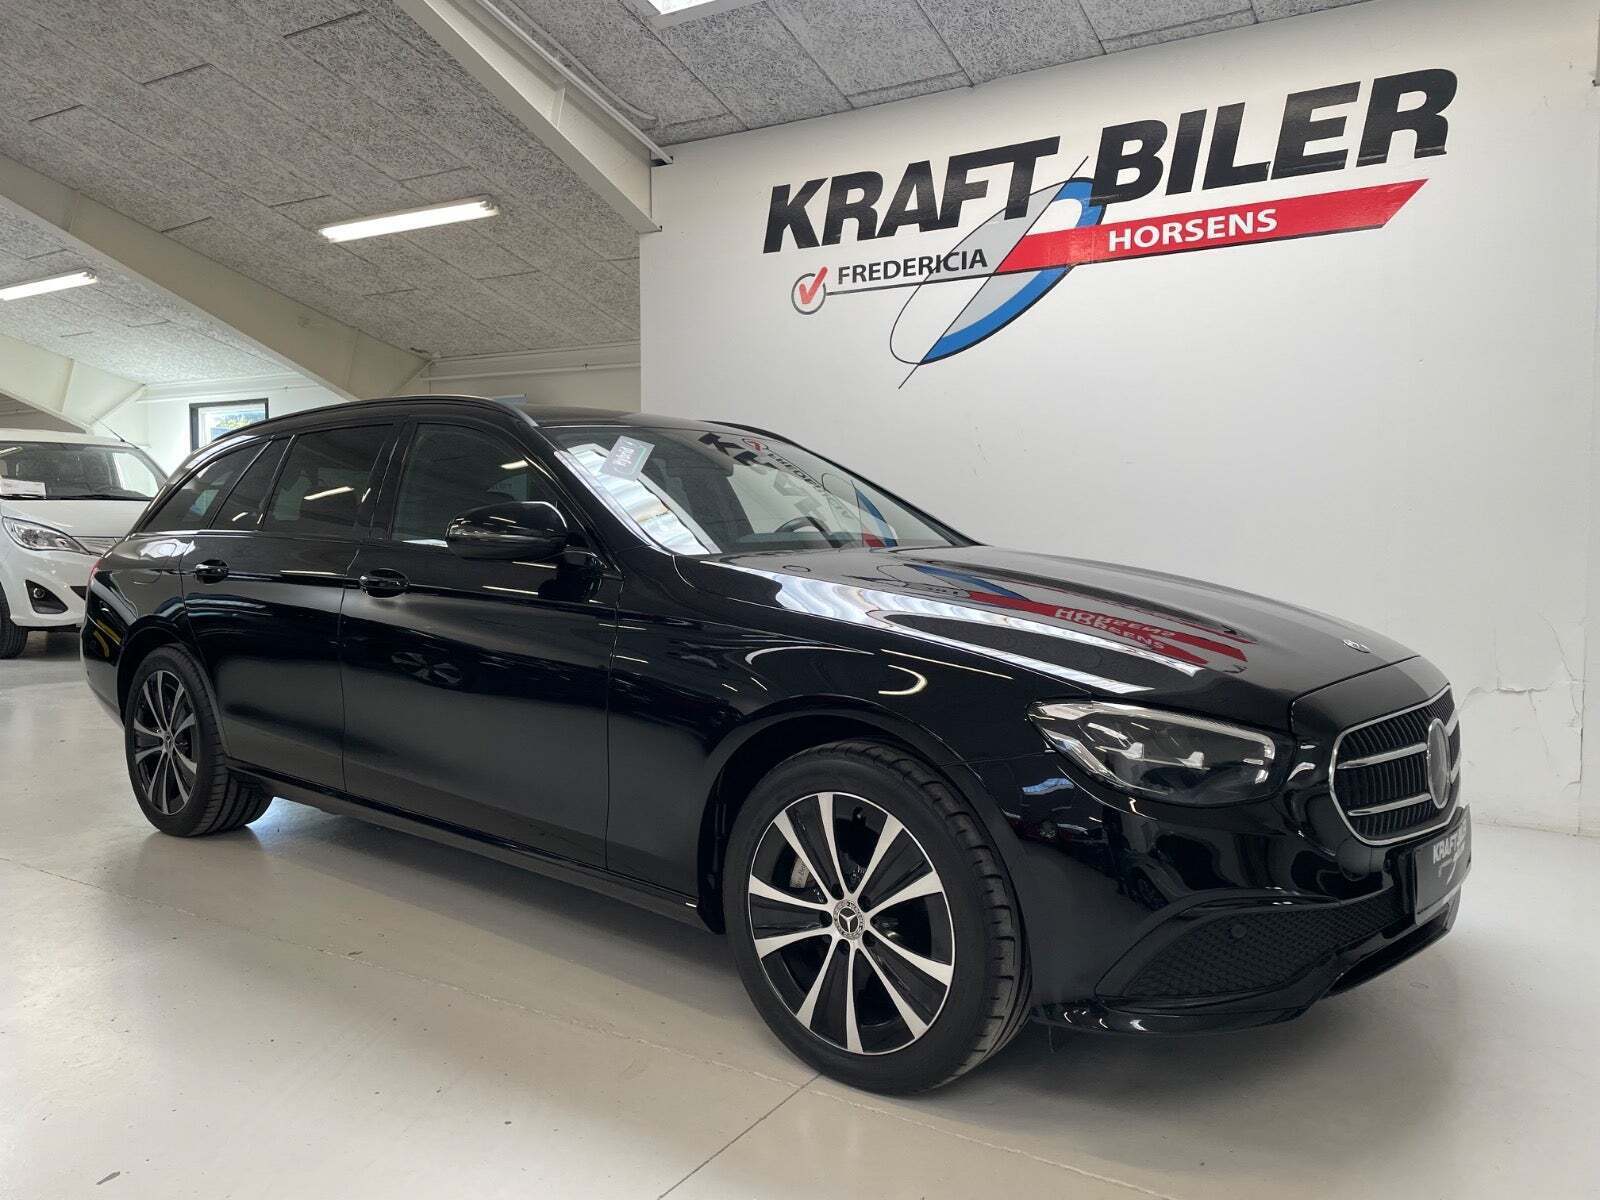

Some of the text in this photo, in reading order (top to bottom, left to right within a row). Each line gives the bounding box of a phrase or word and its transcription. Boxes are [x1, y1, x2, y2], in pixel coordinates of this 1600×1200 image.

[763, 68, 1458, 254] KRAFT BILER
[1108, 208, 1278, 252] HORSENS
[837, 248, 988, 285] FREDERICIA
